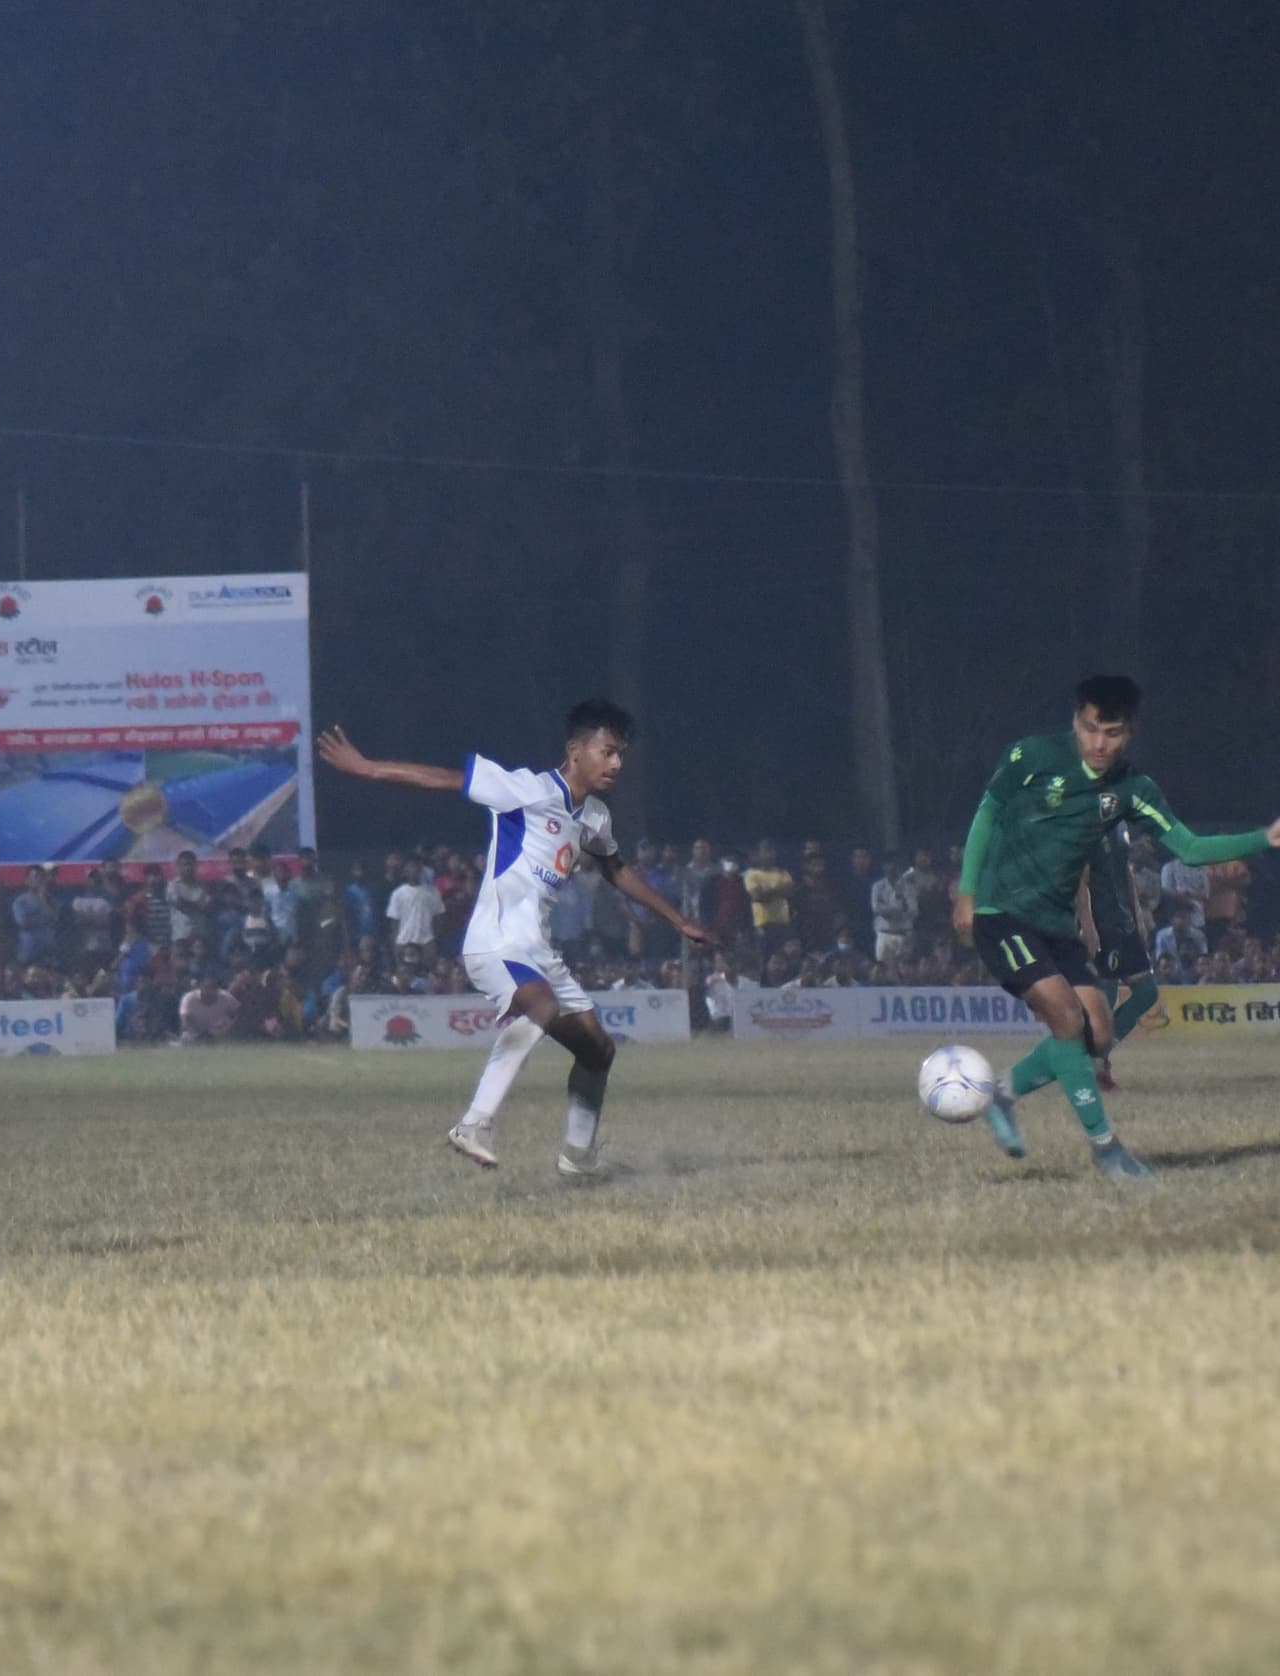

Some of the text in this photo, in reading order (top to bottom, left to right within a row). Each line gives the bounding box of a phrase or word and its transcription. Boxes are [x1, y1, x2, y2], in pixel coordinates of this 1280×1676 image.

[126, 672, 184, 689] Hulas
[190, 669, 265, 692] H-Span
[1000, 935, 1037, 972] 11
[872, 995, 1029, 1023] JAGDAMBA
